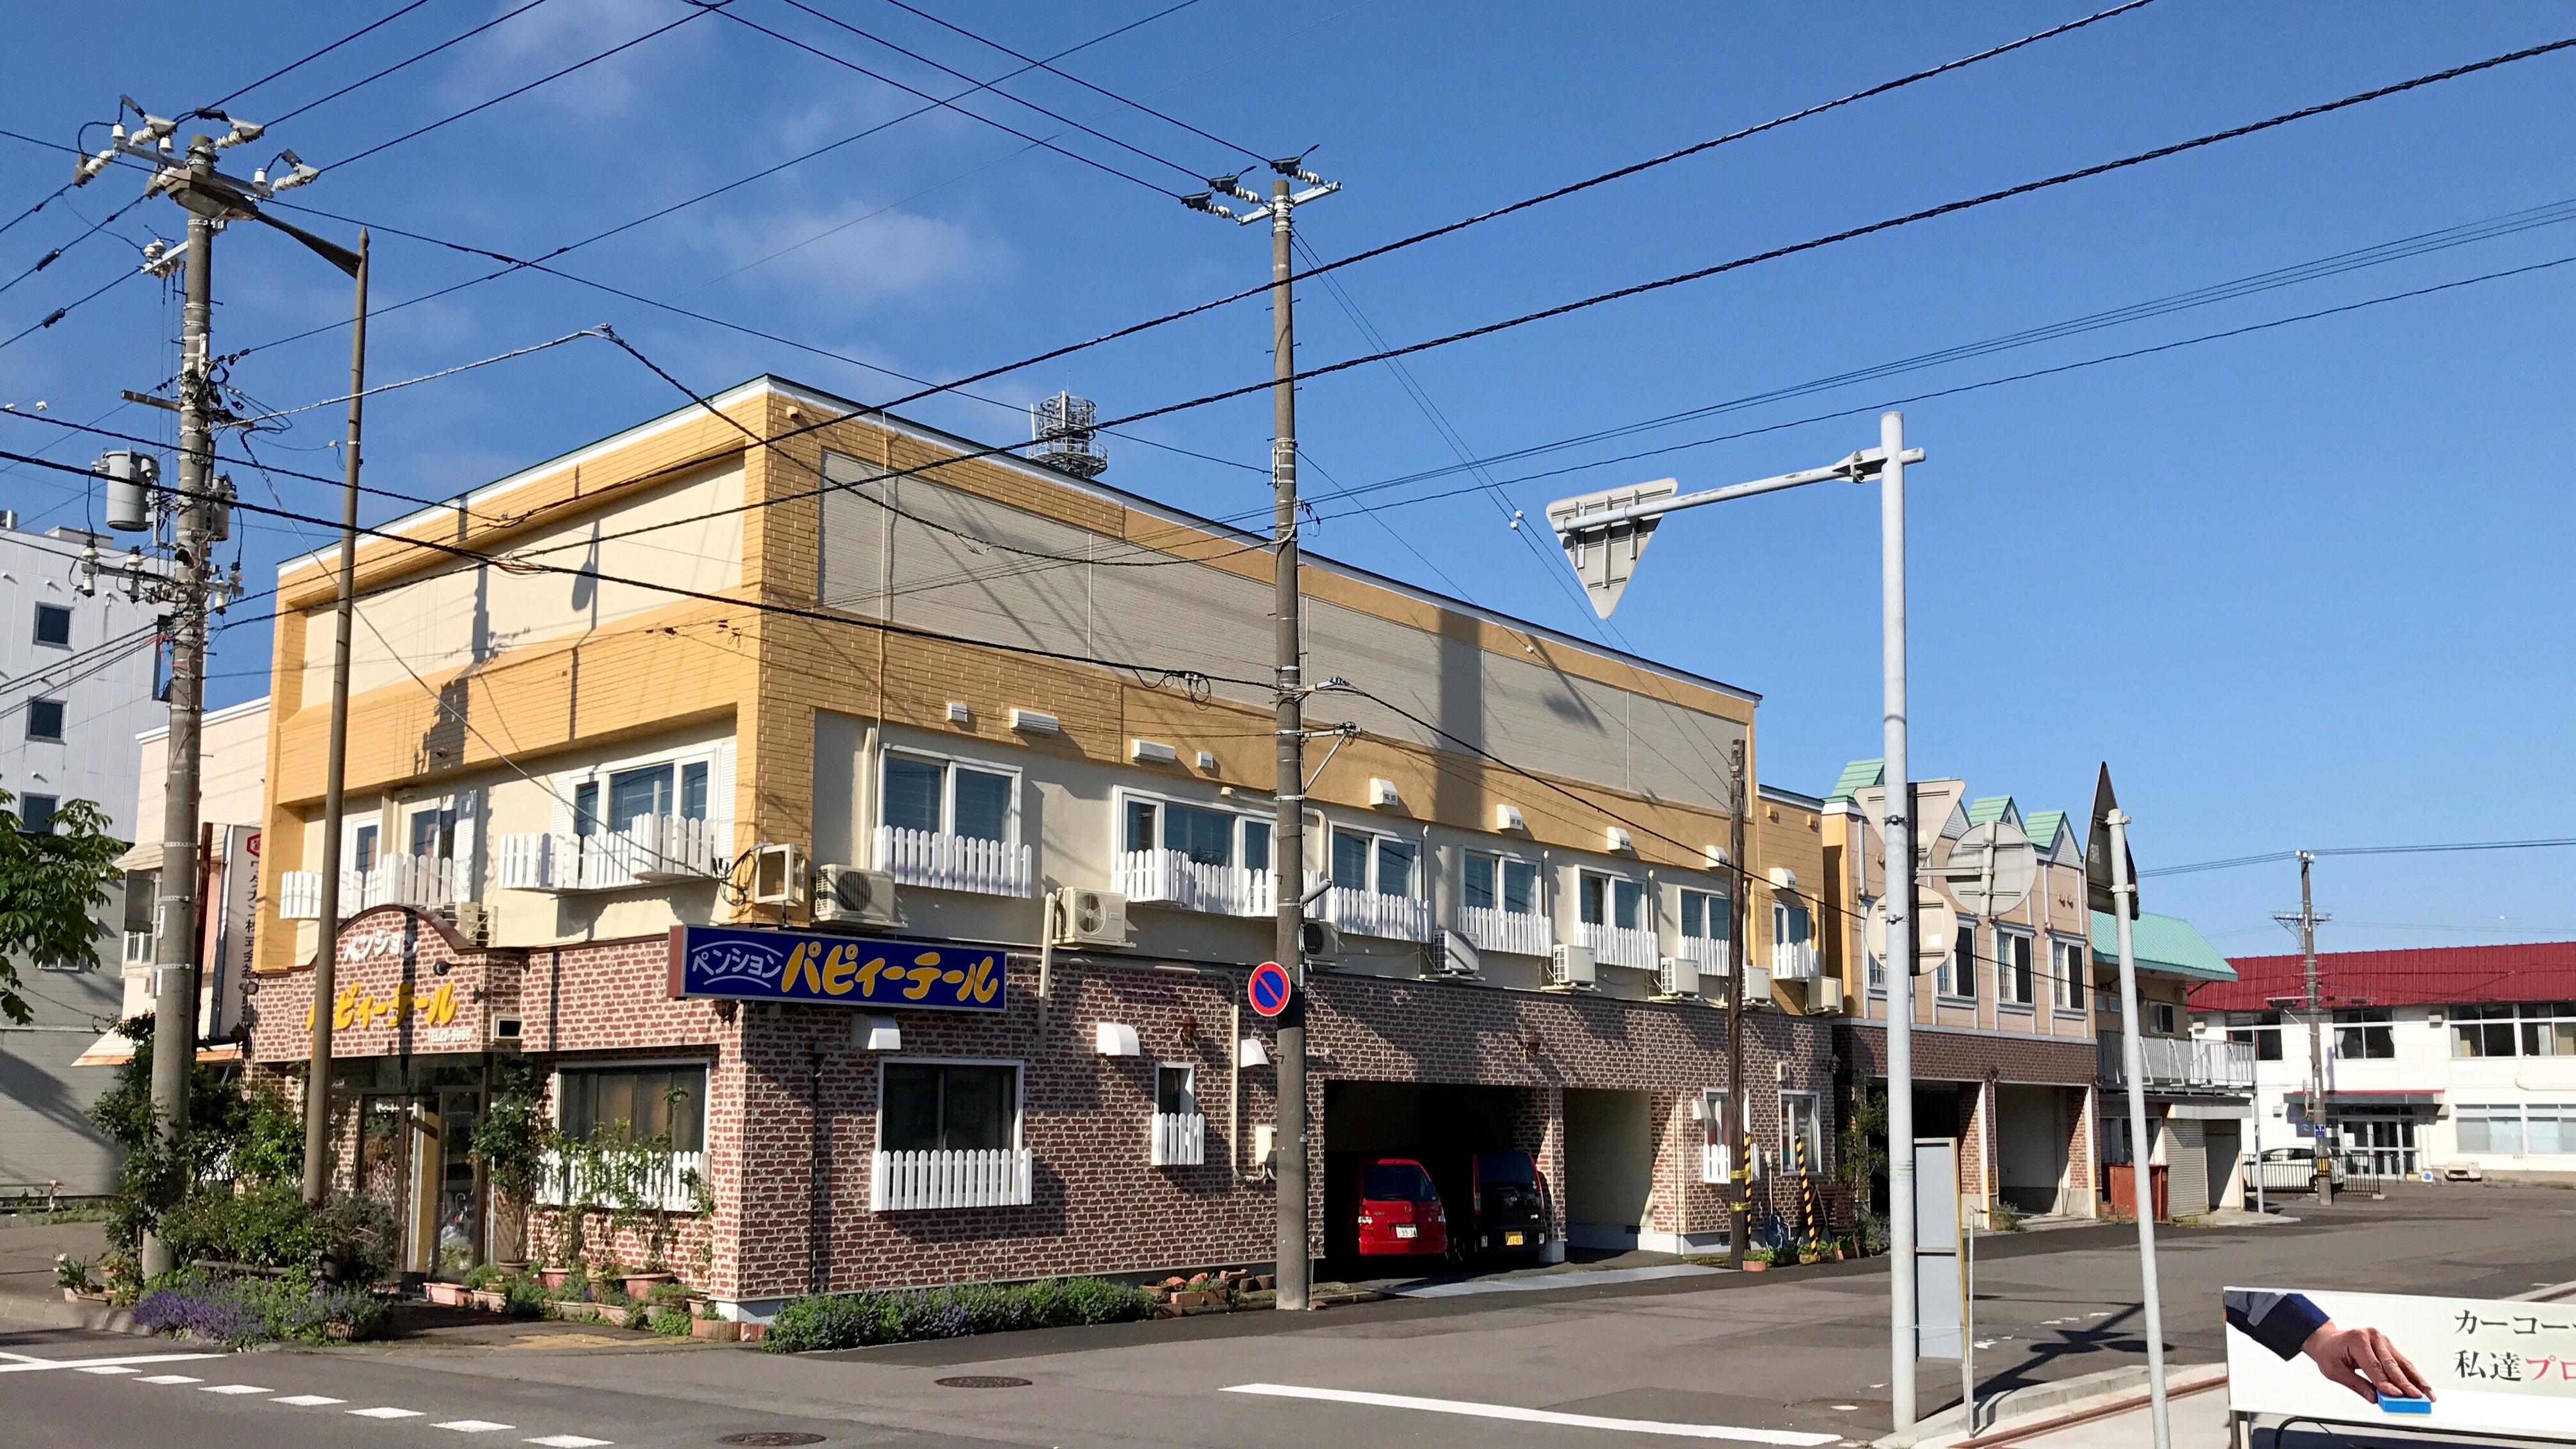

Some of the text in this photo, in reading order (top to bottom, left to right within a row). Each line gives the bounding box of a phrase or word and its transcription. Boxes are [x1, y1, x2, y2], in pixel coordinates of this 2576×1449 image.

[343, 930, 419, 962] ペンション
[692, 941, 999, 1004] ペンション パピィーテール
[2454, 1309, 2576, 1335] カーコー
[2453, 1349, 2576, 1382] 私達プロ
